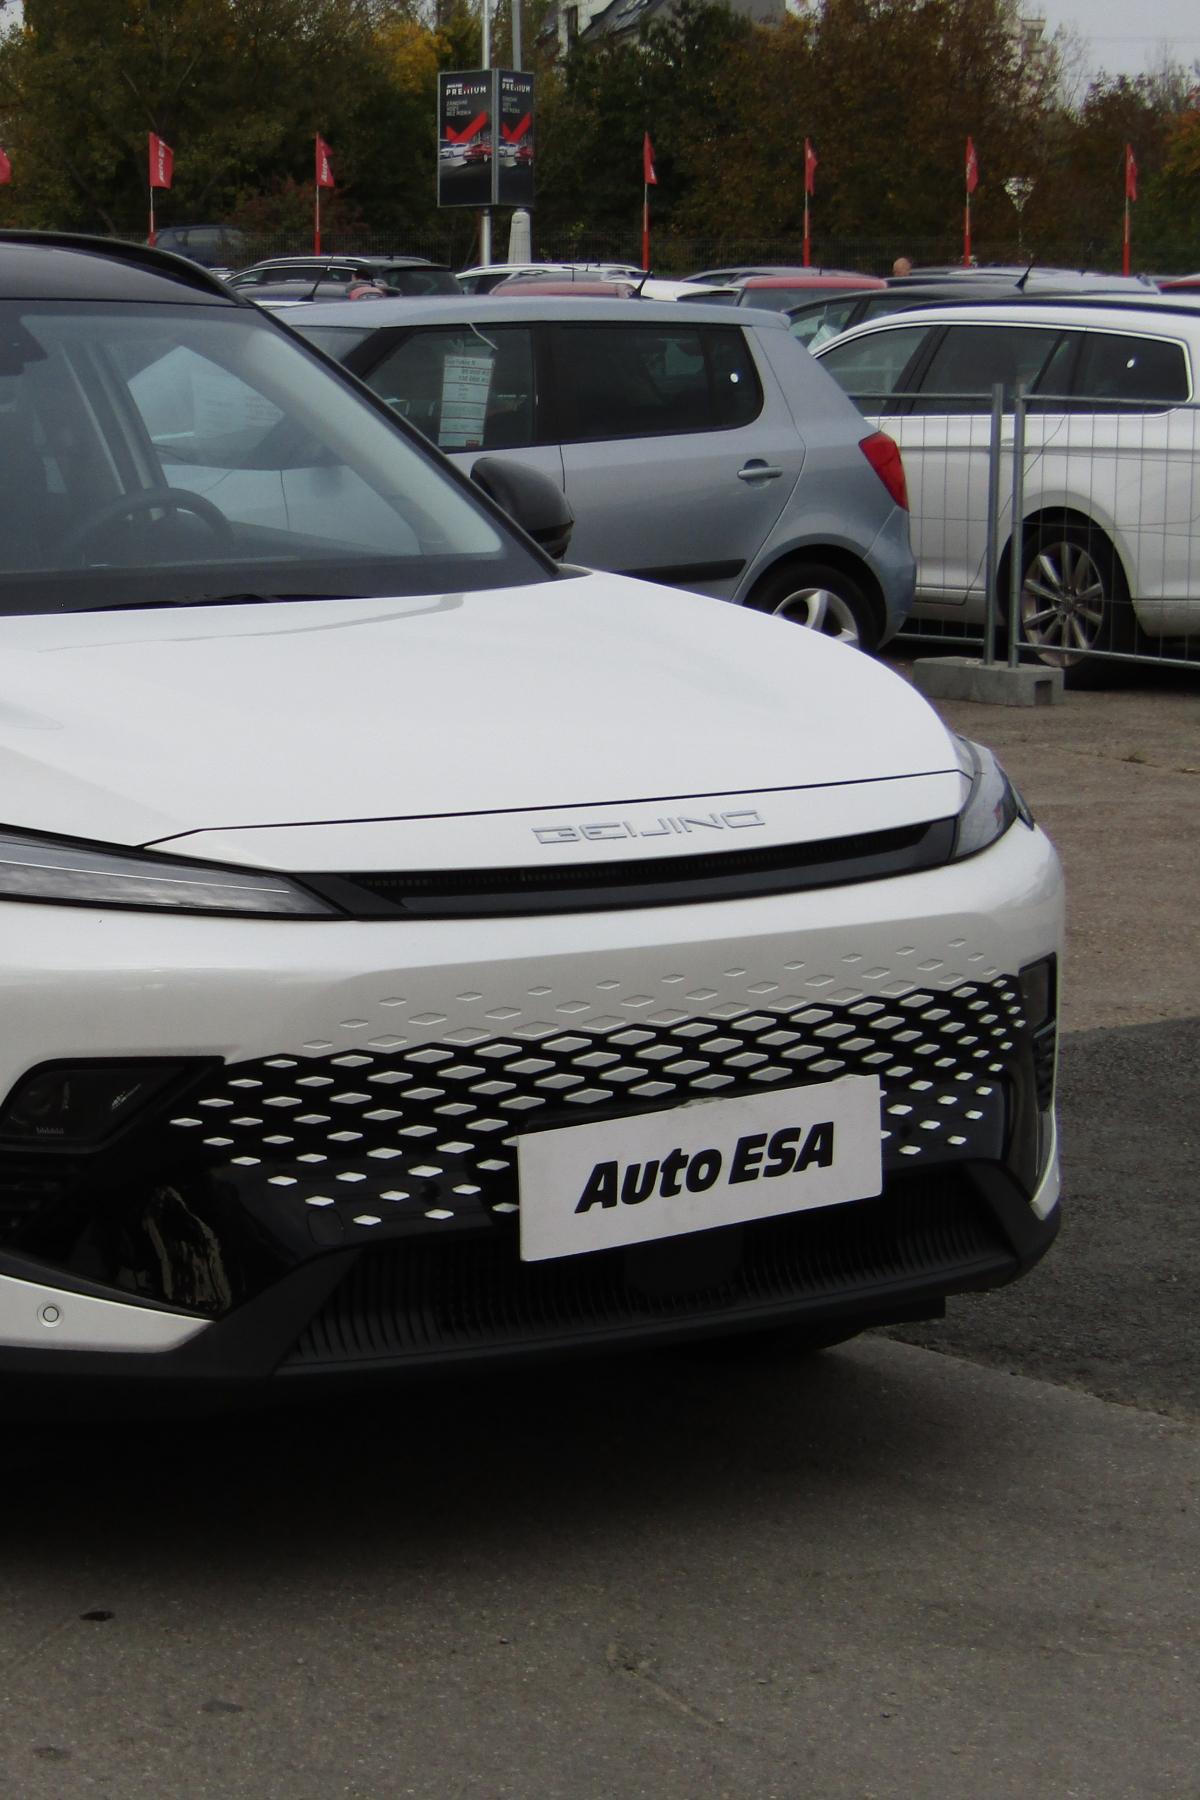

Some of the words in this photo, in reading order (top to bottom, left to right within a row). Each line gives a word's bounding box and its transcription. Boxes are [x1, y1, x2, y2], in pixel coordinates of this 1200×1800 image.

[445, 85, 487, 96] PREMIUM
[574, 1147, 722, 1214] Auto
[728, 1121, 834, 1185] ESA
